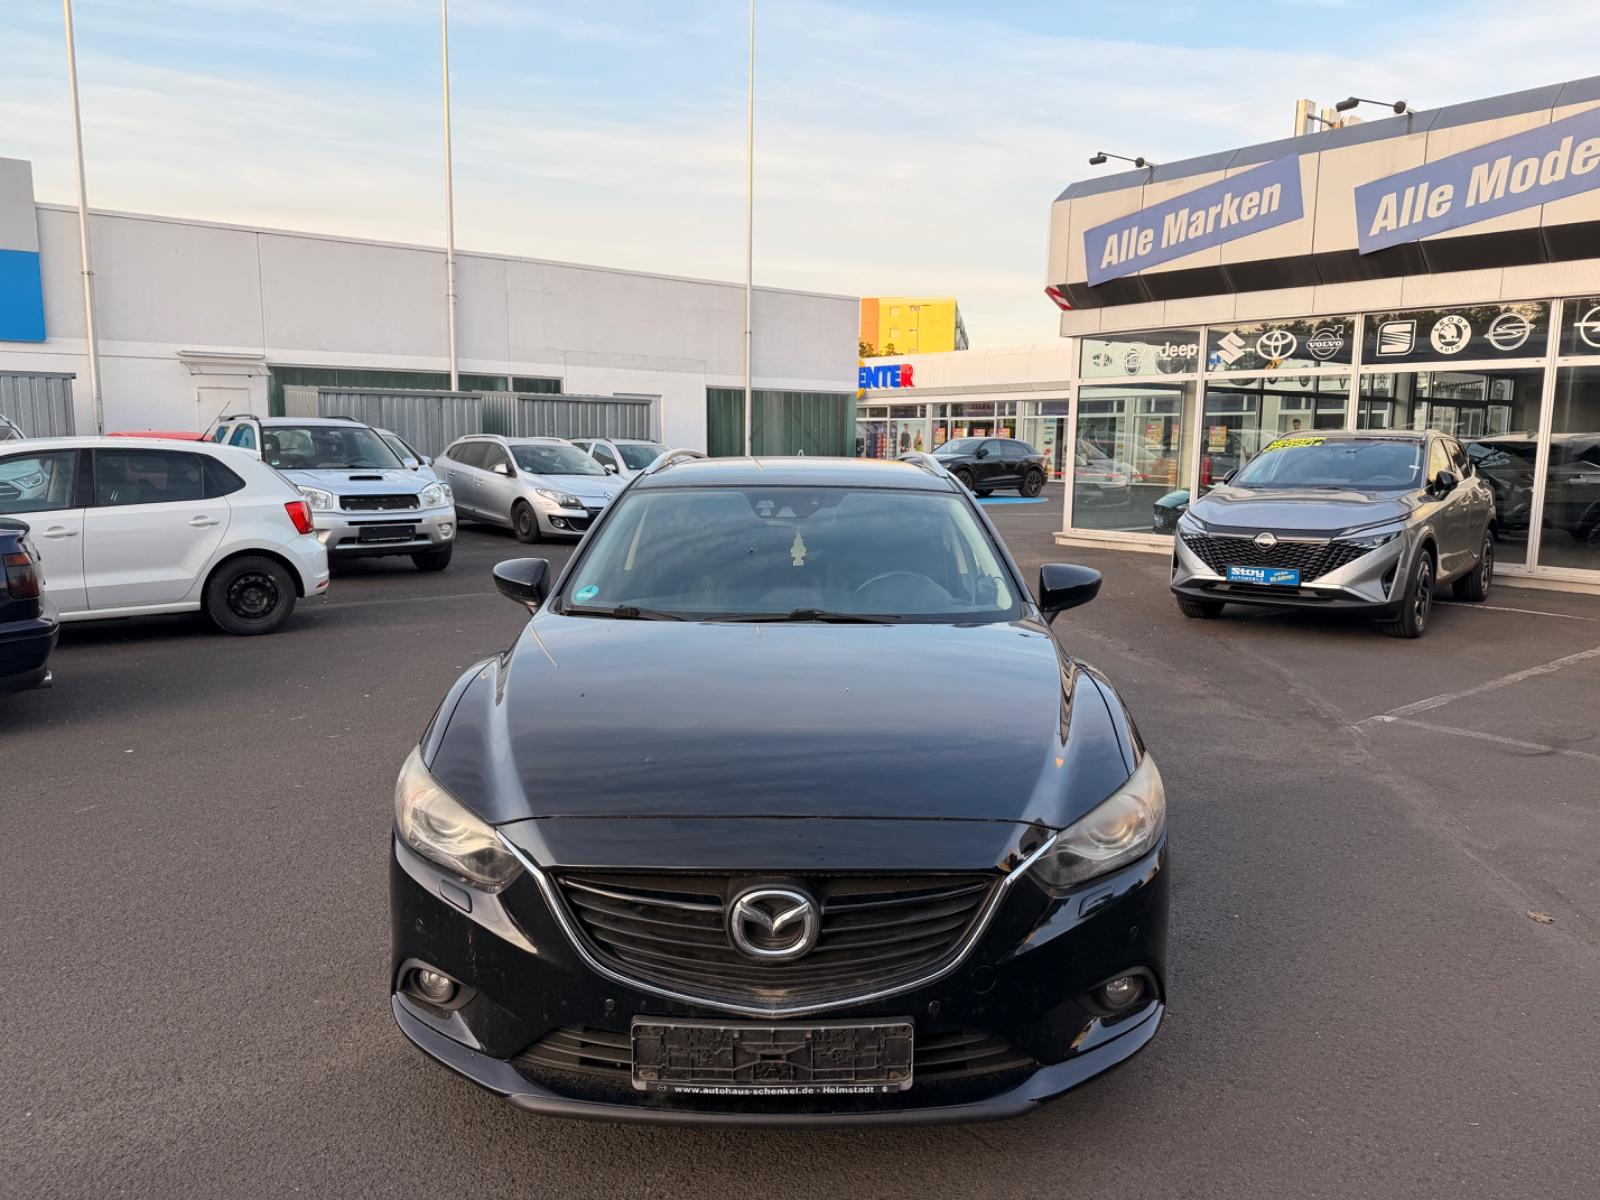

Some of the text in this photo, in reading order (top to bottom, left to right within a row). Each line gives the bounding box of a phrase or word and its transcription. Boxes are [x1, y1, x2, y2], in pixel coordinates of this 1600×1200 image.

[1368, 135, 1600, 237] Alle Mode
[1100, 182, 1282, 270] Alle Marken
[1159, 341, 1198, 359] Jeep
[1308, 340, 1342, 348] VOLVO
[1439, 344, 1461, 353] AUTO
[1231, 568, 1264, 577] Stoy
